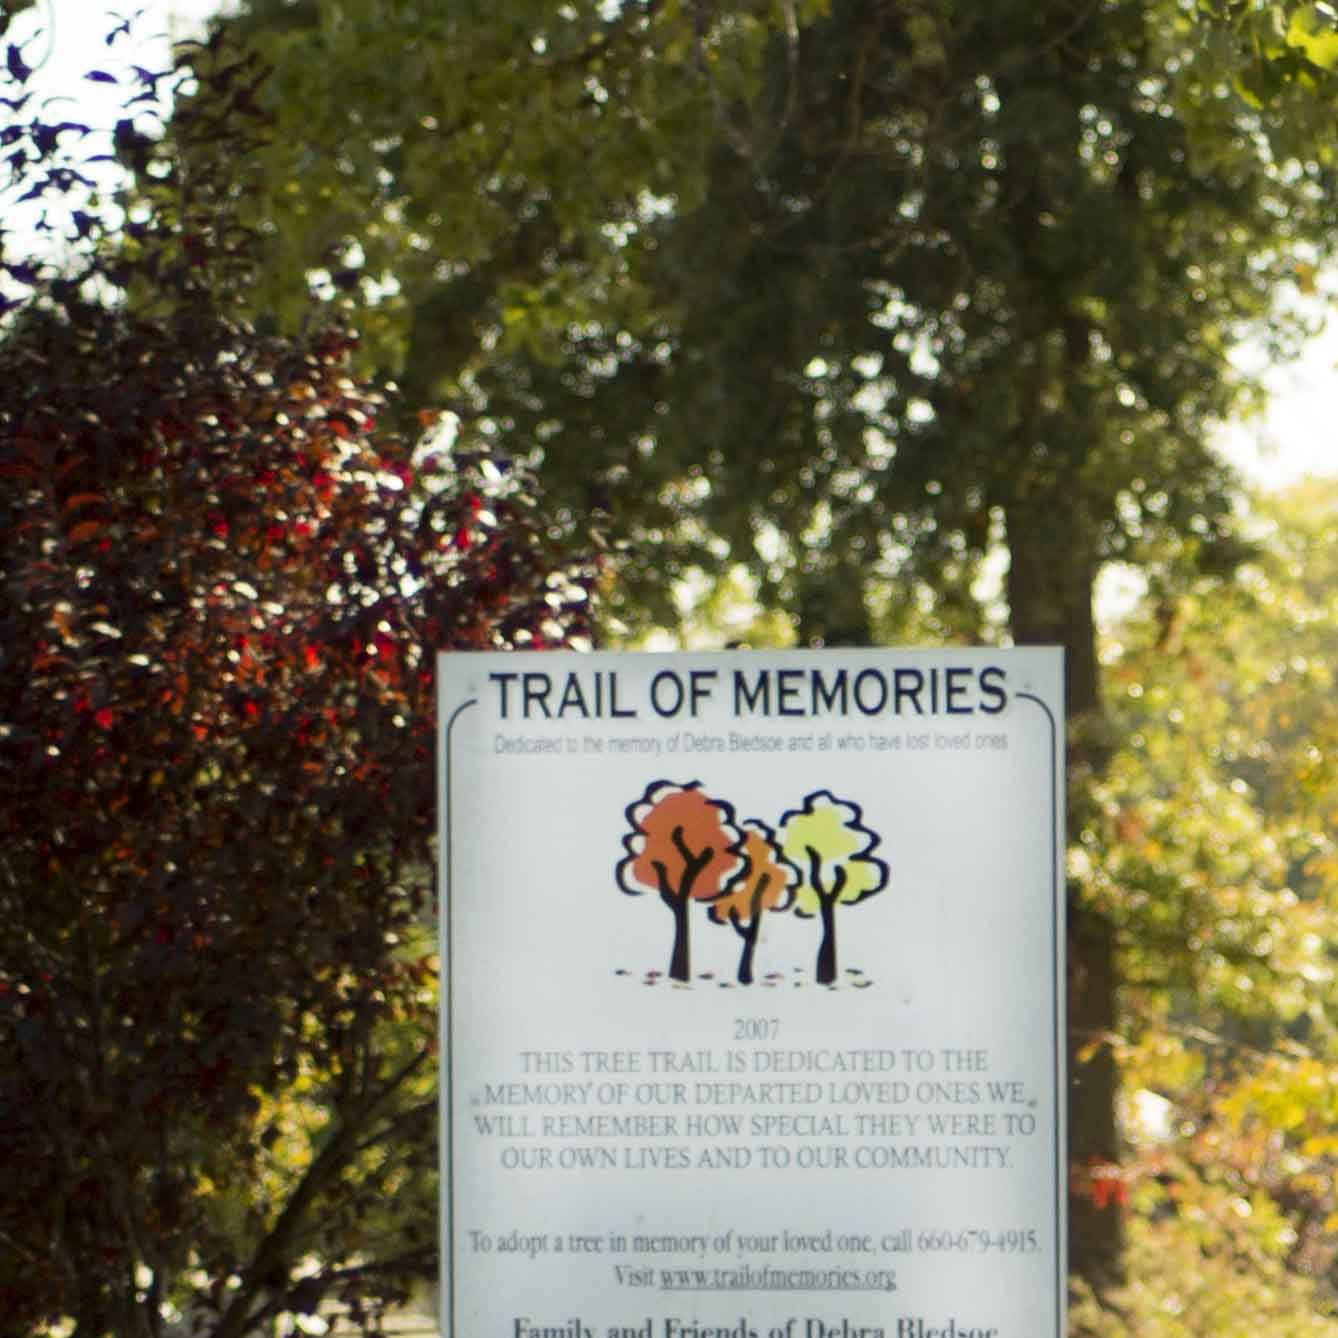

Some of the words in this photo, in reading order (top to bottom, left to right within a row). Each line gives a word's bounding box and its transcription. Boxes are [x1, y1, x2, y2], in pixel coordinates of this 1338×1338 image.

[488, 671, 637, 719] TRAIL
[649, 669, 719, 717] OF
[732, 666, 1009, 717] MEMORIES
[493, 733, 562, 755] Dedicated
[565, 733, 579, 754] to
[582, 733, 604, 754] the
[607, 738, 662, 758] memory
[665, 732, 680, 754] of
[682, 731, 725, 754] Debra
[728, 731, 783, 754] Bledsoe
[786, 732, 814, 753] and
[817, 732, 832, 753] all
[836, 732, 865, 753] who
[868, 732, 901, 753] have
[906, 731, 930, 752] lost
[933, 731, 971, 752] loved
[974, 735, 1008, 752] ones
[733, 1017, 781, 1042] 2007
[517, 1049, 575, 1073] THIS
[580, 1049, 641, 1073] TREE
[647, 1049, 720, 1073] TRAIL
[725, 1049, 747, 1073] IS
[752, 1048, 896, 1073] DEDICATED
[901, 1048, 935, 1072] TO
[940, 1048, 989, 1072] THE
[484, 1081, 594, 1105] MEMORY
[597, 1081, 630, 1105] OF
[634, 1081, 688, 1105] OUR
[694, 1081, 823, 1105] DEPARTED
[829, 1081, 910, 1105] LOVED
[473, 1113, 537, 1138] WILL
[542, 1113, 680, 1138] REMEMBER
[685, 1113, 744, 1138] HOW
[750, 1113, 849, 1138] SPECIAL
[854, 1113, 921, 1138] THEY
[926, 1112, 997, 1137] WERE
[1003, 1112, 1037, 1137] TO
[500, 1145, 553, 1170] OUR
[557, 1145, 617, 1170] OWN
[624, 1145, 691, 1170] LIVES
[696, 1145, 752, 1170] AND
[757, 1145, 791, 1170] TO
[796, 1145, 850, 1170] OUR
[854, 1144, 1014, 1169] COMMUNITY.
[468, 1230, 492, 1253] To
[497, 1229, 549, 1259] adopt
[553, 1236, 563, 1253] a
[567, 1233, 604, 1253] tree
[608, 1230, 627, 1253] in
[632, 1235, 708, 1259] memory
[712, 1229, 734, 1253] of
[736, 1235, 779, 1259] your
[782, 1229, 832, 1253] loved
[836, 1234, 877, 1255] one,
[880, 1229, 912, 1252] call
[614, 1265, 656, 1287] Visit
[659, 1263, 897, 1291] www.trailofmemories.org
